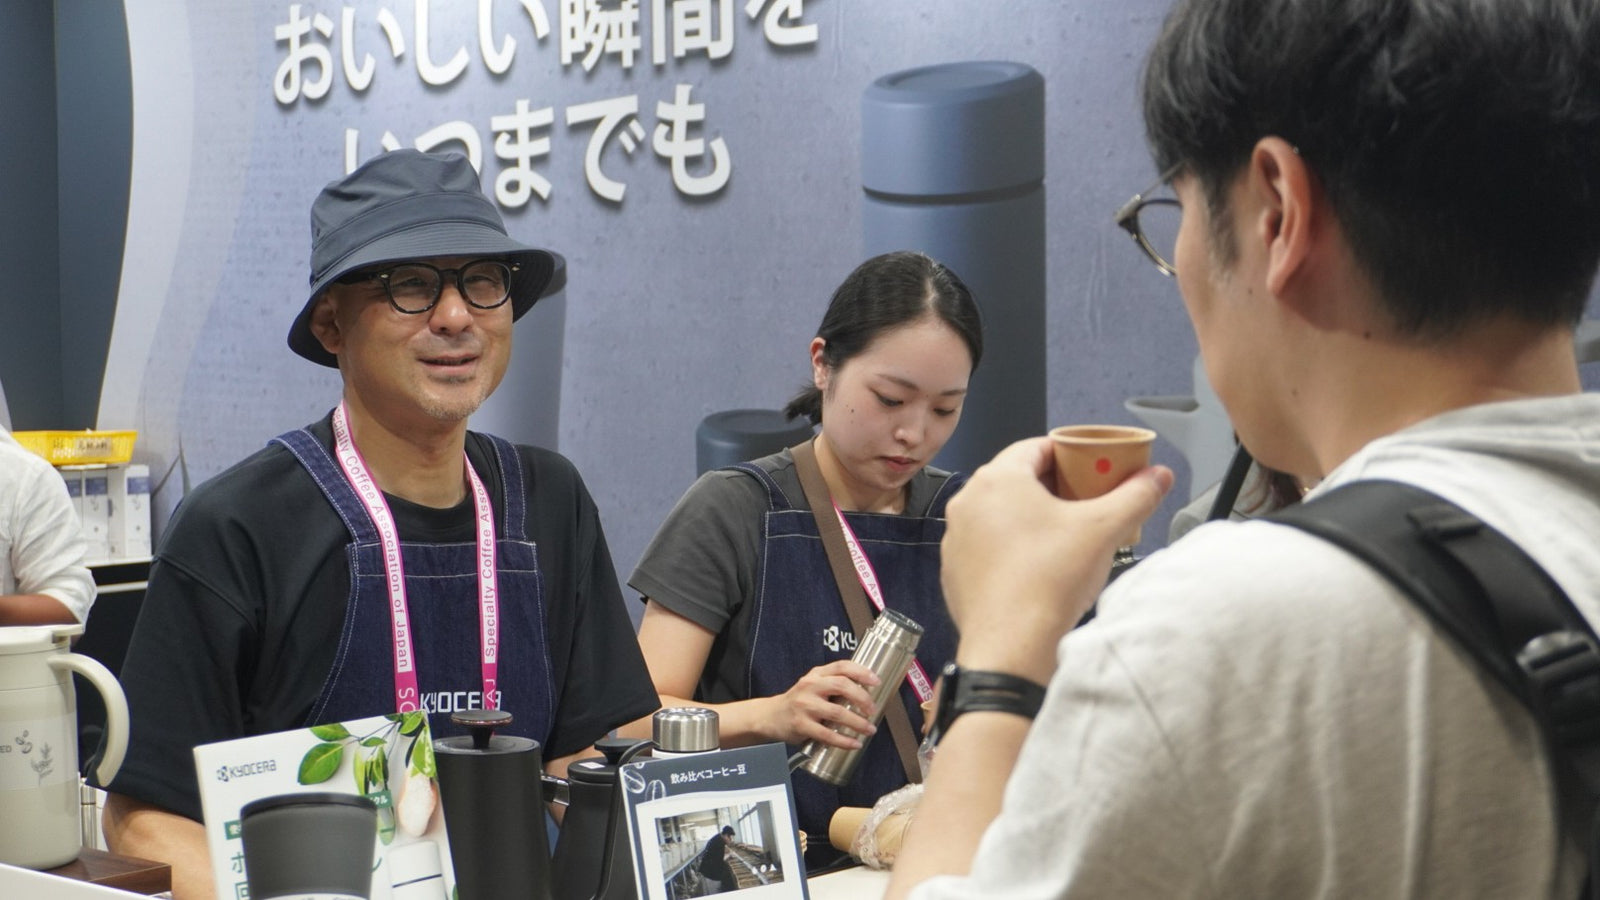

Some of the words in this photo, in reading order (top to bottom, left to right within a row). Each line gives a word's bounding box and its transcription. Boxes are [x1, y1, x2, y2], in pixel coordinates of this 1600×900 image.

[345, 455, 375, 500] Coffee
[372, 505, 400, 592] Association
[481, 529, 493, 580] Coffee
[847, 540, 871, 579] Coffee
[393, 599, 405, 614] of
[483, 586, 497, 657] Specialty
[396, 620, 409, 668] Japan
[420, 691, 502, 713] KYOCEA
